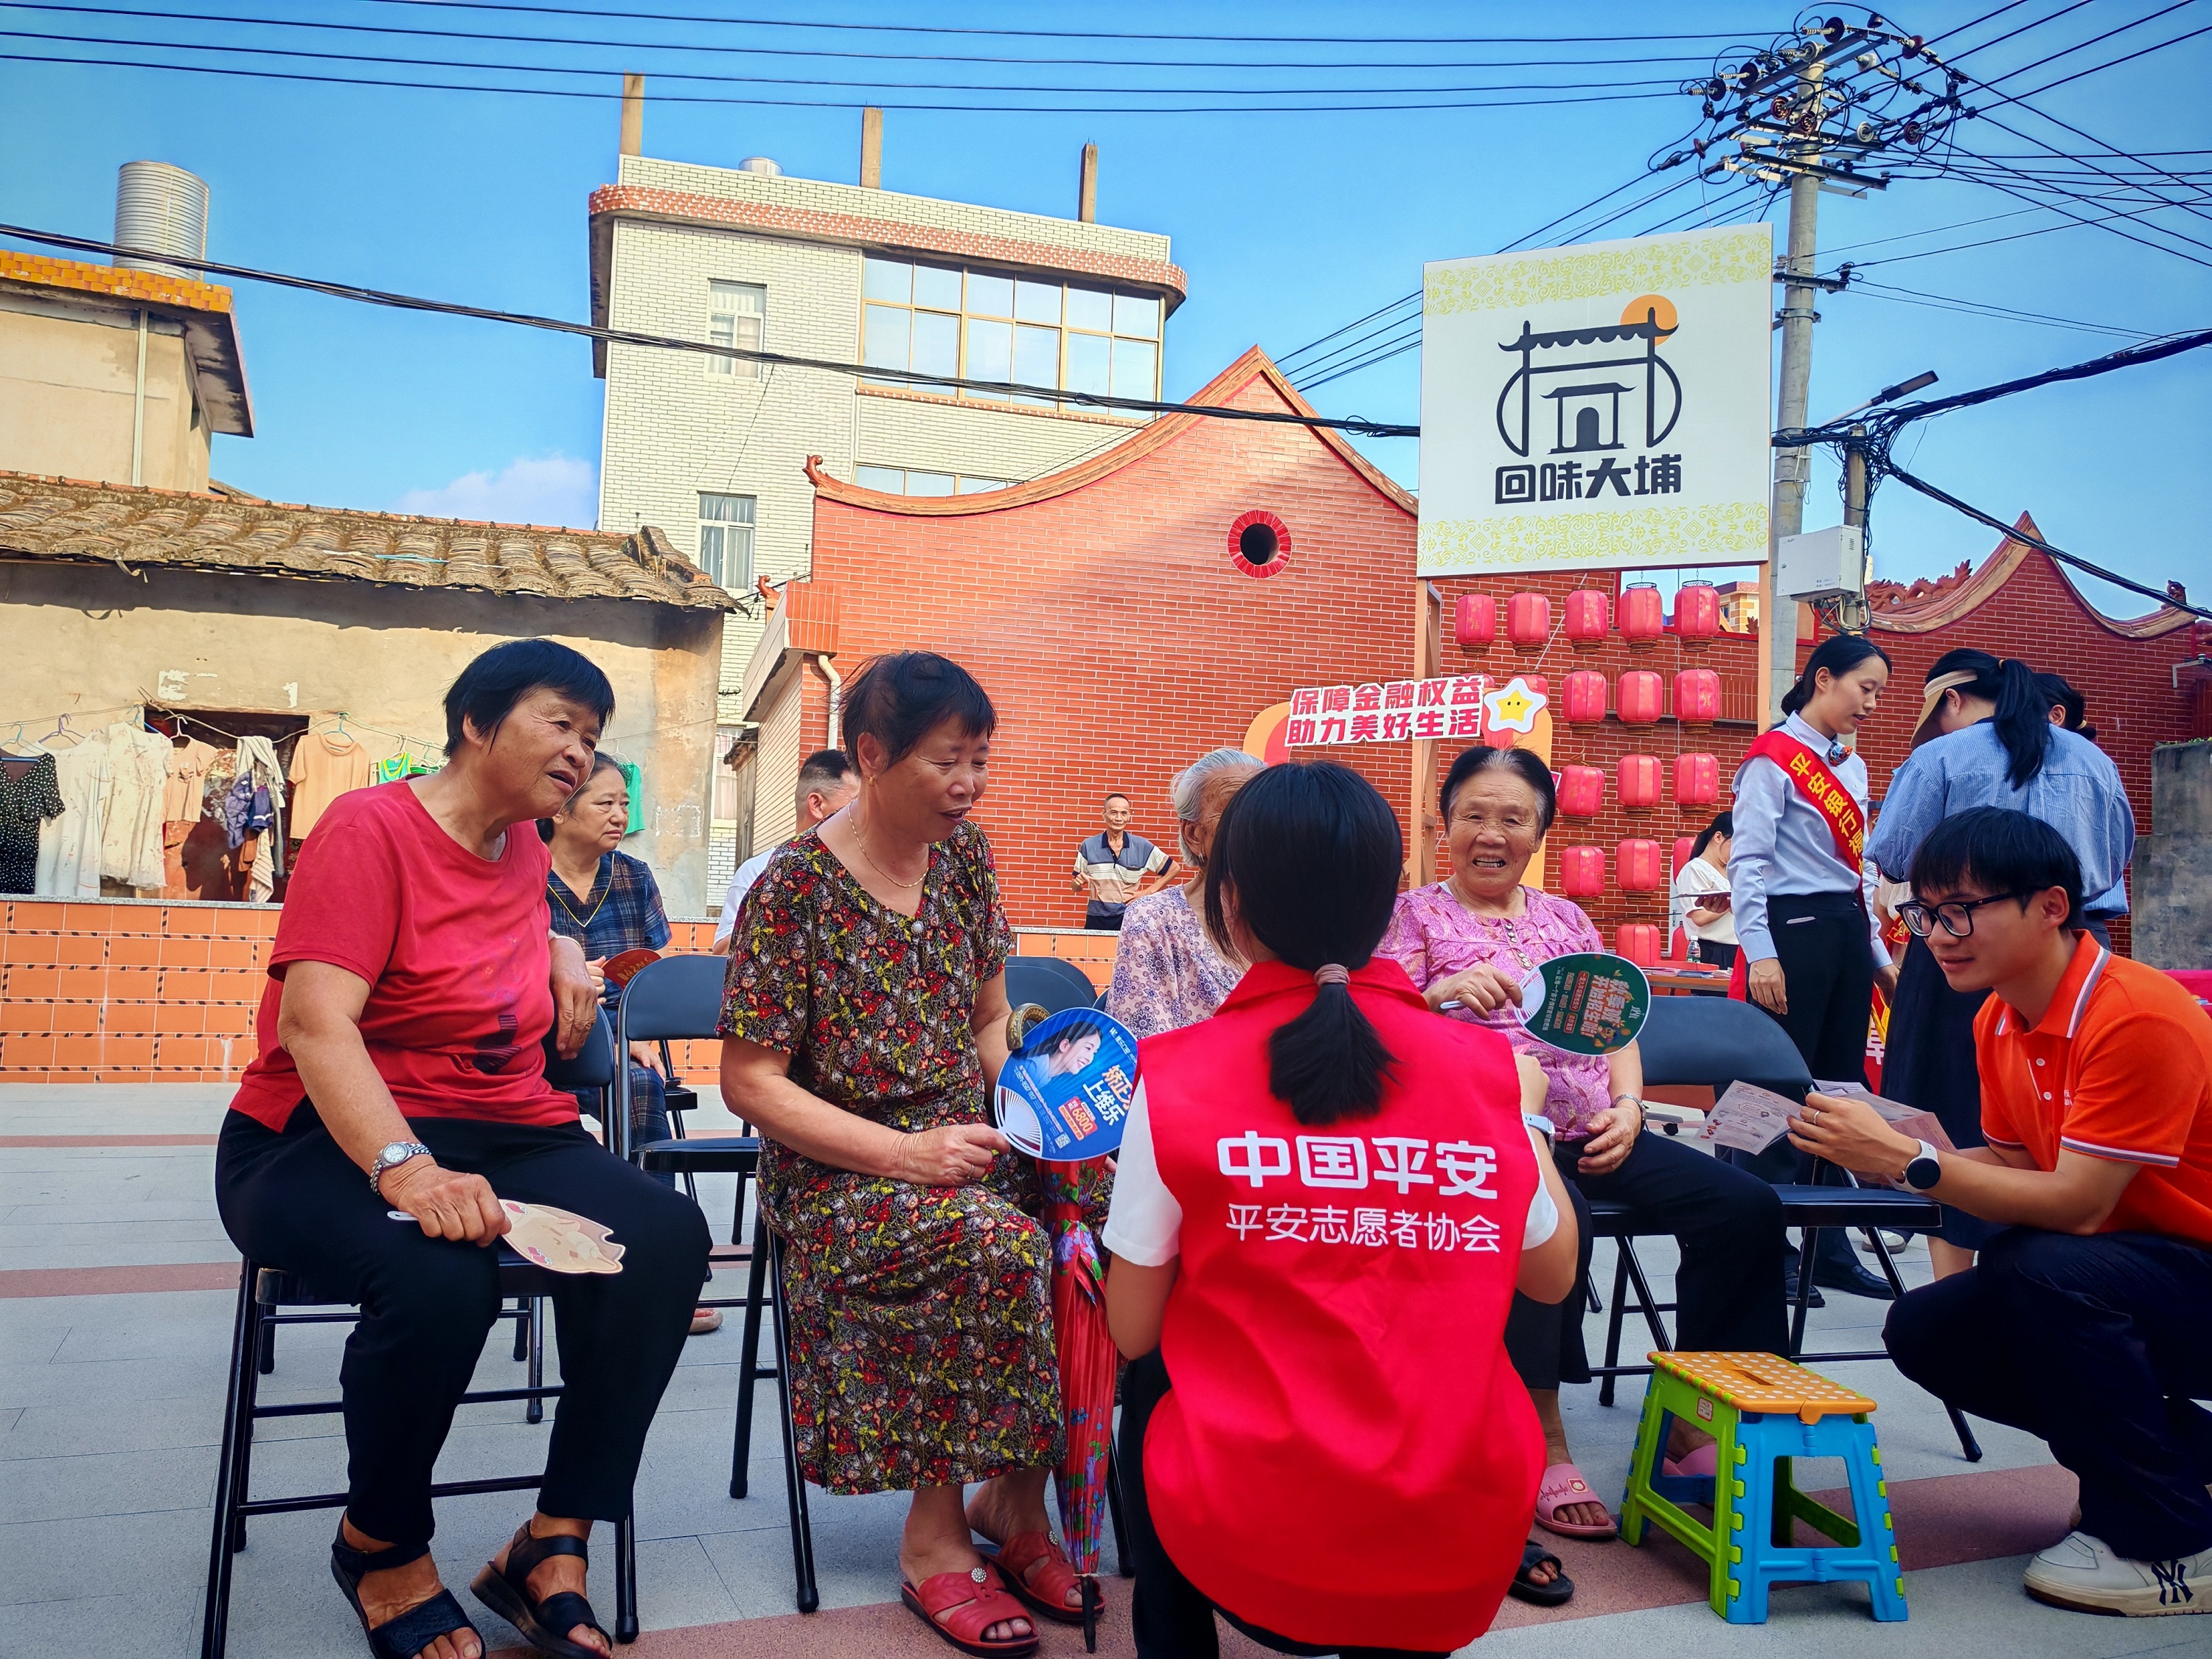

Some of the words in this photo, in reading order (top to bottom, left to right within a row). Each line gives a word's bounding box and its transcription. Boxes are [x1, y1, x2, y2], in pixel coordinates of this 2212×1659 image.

[1495, 453, 1683, 505] 回味大埔
[1291, 675, 1484, 717] 保障金融权益
[1286, 709, 1480, 745] 助力美好生活
[1601, 978, 1630, 1025] 秋季班
[1072, 1107, 1093, 1132] 6800
[1082, 1079, 1125, 1126] 上维乐
[1217, 1130, 1498, 1200] 中国平安
[1225, 1203, 1500, 1253] 平安志愿者协会
